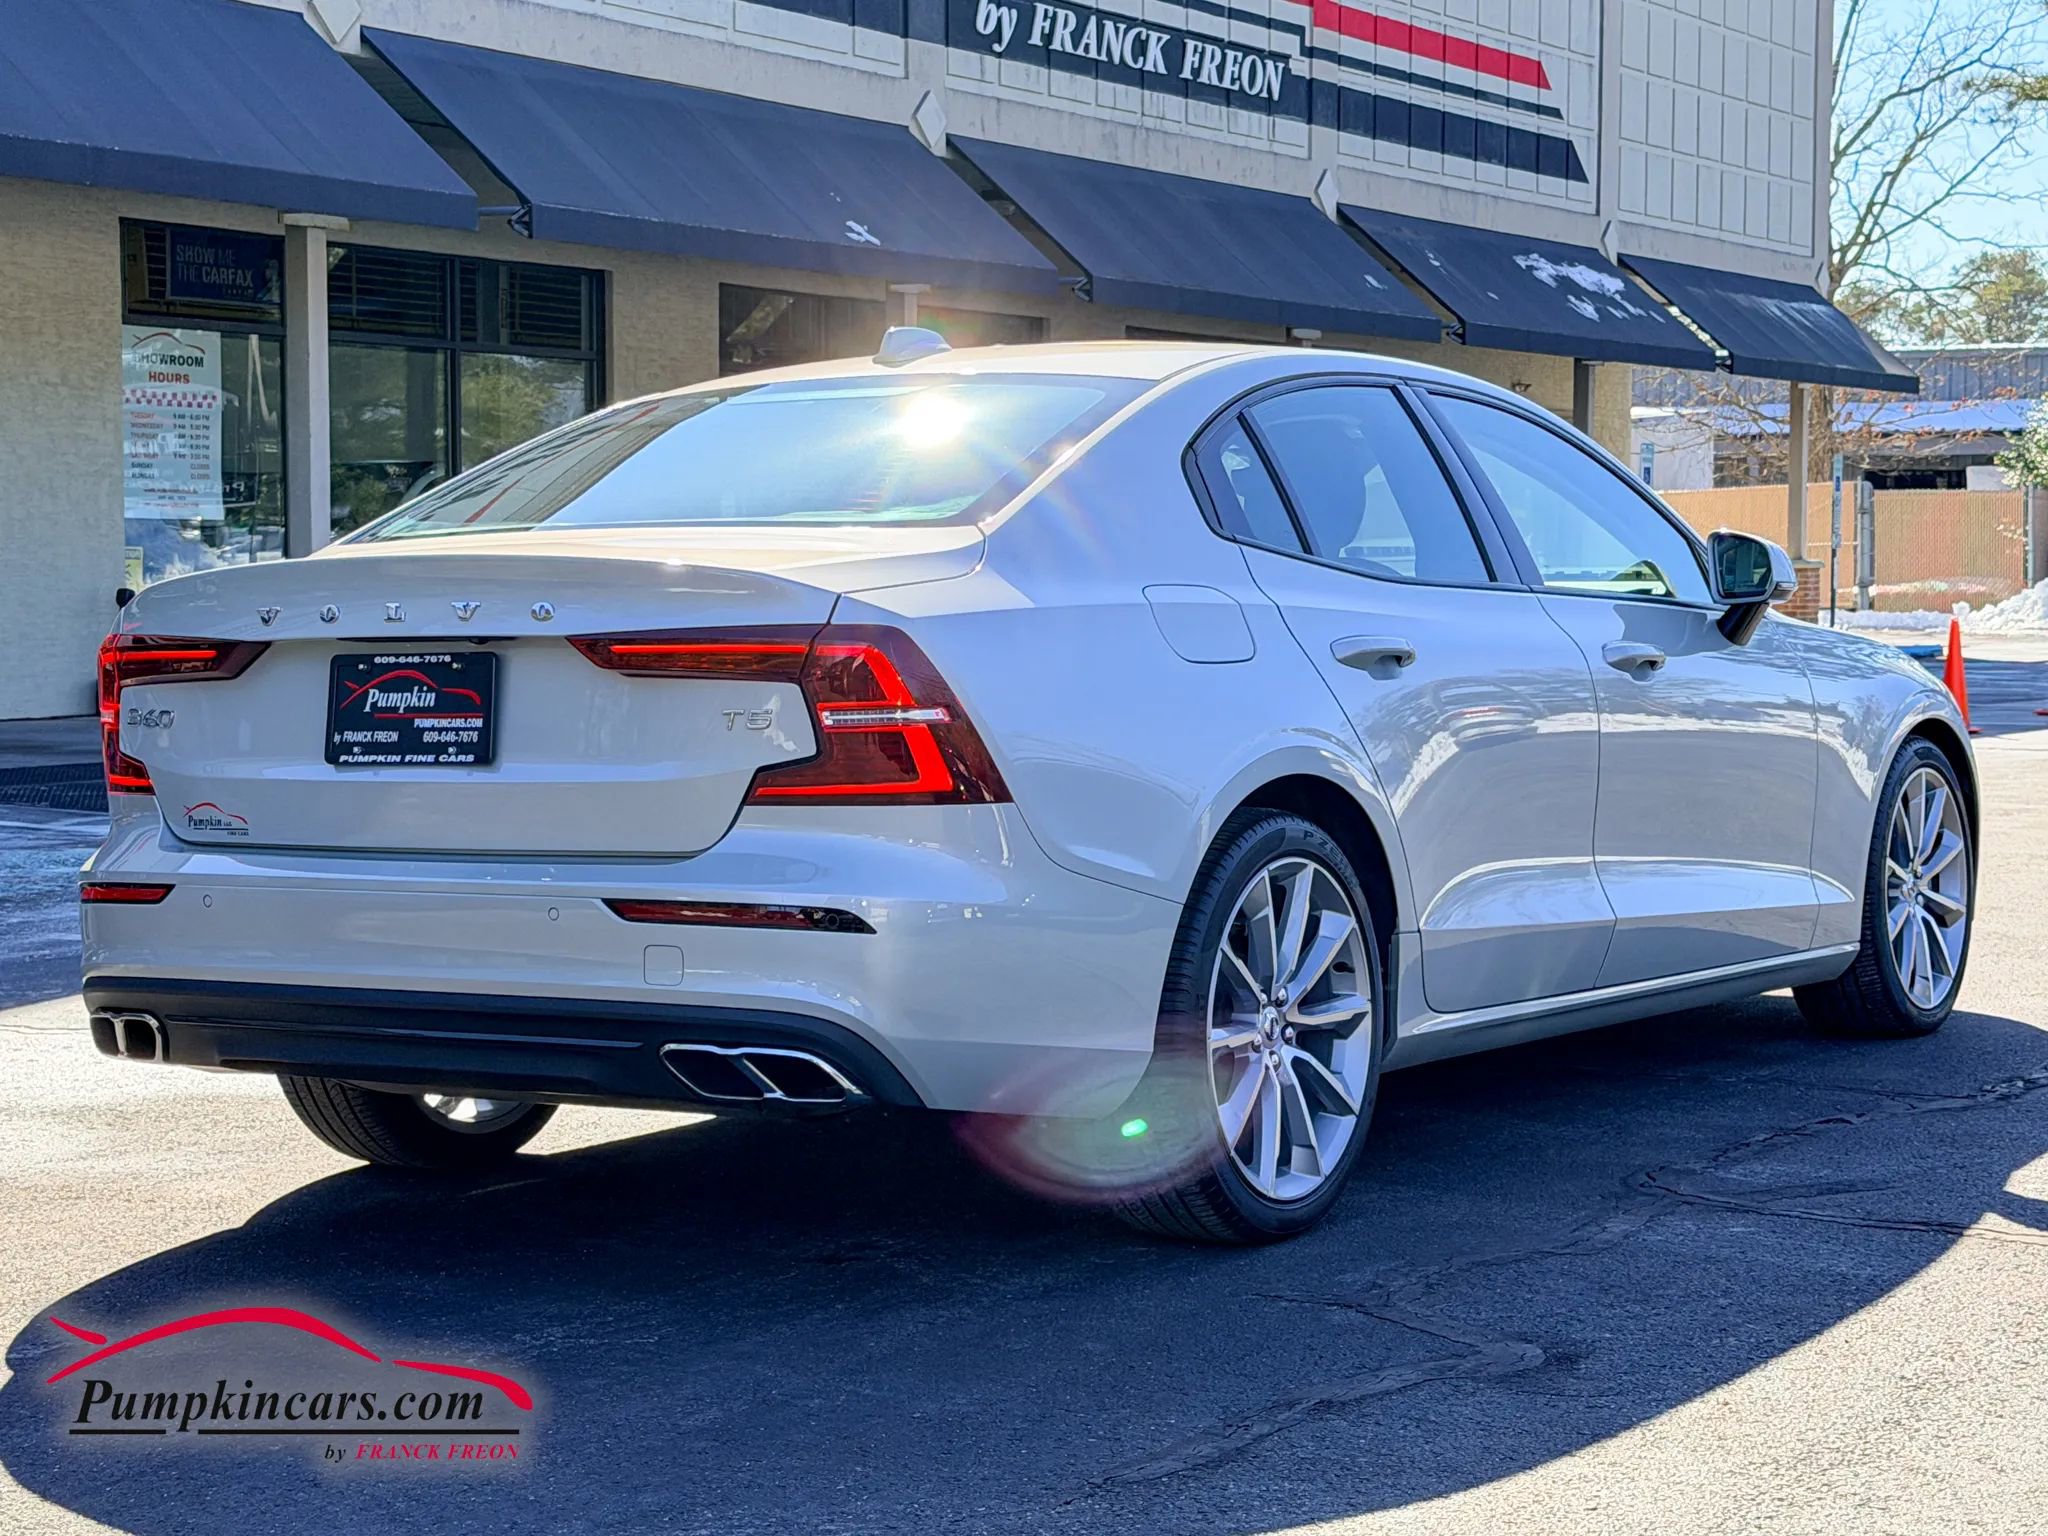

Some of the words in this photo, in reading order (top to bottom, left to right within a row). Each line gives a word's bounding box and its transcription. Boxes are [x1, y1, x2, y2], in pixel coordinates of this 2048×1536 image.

[975, 0, 1017, 52] by
[1027, 2, 1171, 75] FRANCK
[1179, 38, 1286, 101] FREON
[176, 244, 215, 264] SHOW
[177, 262, 200, 282] THE
[202, 266, 253, 287] CARFAX
[149, 371, 190, 384] HOURS
[256, 601, 556, 627] VOLVO
[374, 655, 451, 664] 609-646-7676
[363, 686, 436, 713] Pumpkin
[414, 718, 483, 728] PUMPKINCARS.COM
[722, 709, 773, 731] T5
[333, 732, 342, 745] by
[342, 731, 372, 743] FRANCK
[373, 731, 399, 743] FREON
[423, 731, 478, 743] 609-646-7676
[339, 754, 401, 763] PUMPKIN
[404, 754, 435, 763] FINE
[439, 754, 475, 763] CARS
[188, 815, 222, 830] Pumpkin
